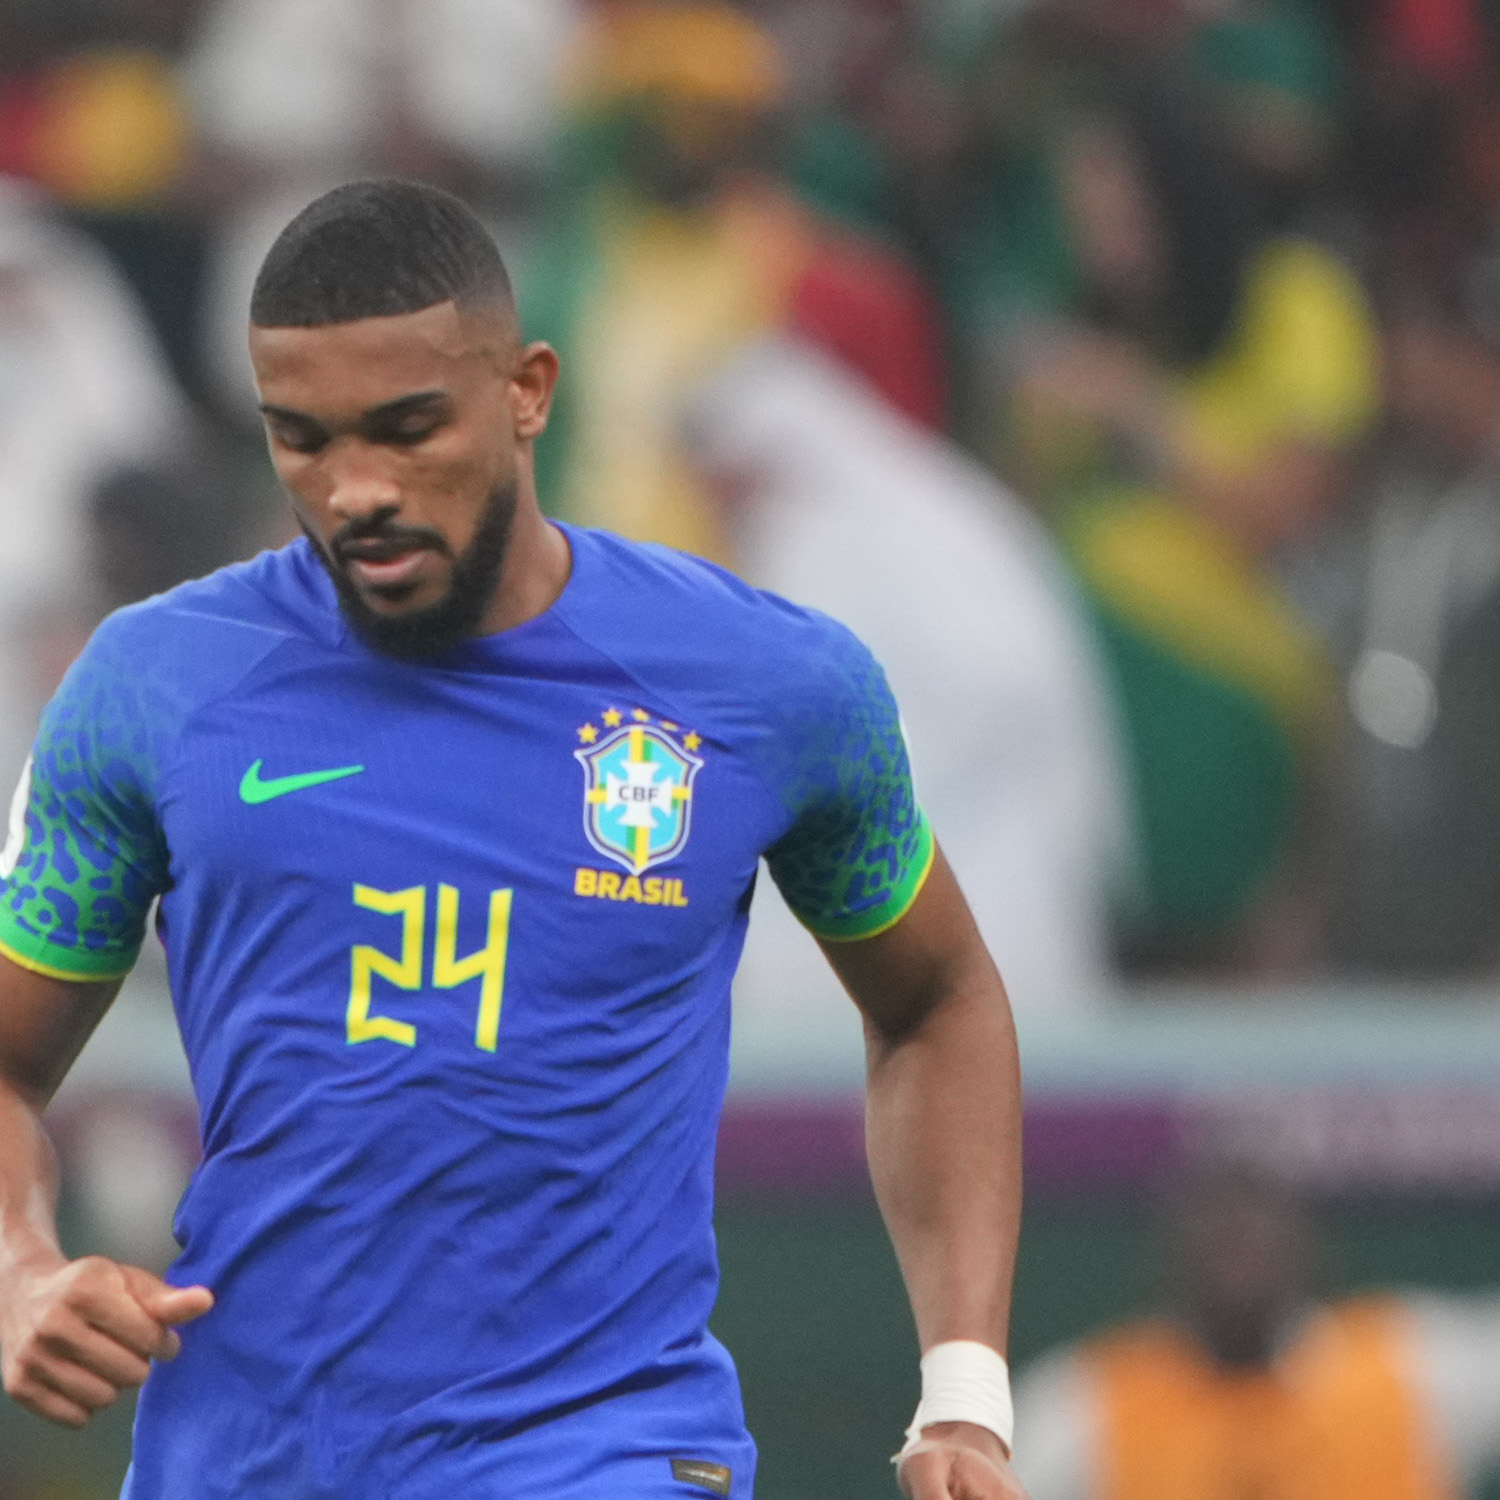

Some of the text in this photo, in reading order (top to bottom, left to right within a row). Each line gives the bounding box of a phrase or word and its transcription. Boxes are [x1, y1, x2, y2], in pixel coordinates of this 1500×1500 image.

[618, 785, 660, 802] CBF
[574, 867, 690, 907] BRASIL
[346, 881, 514, 1054] 24
